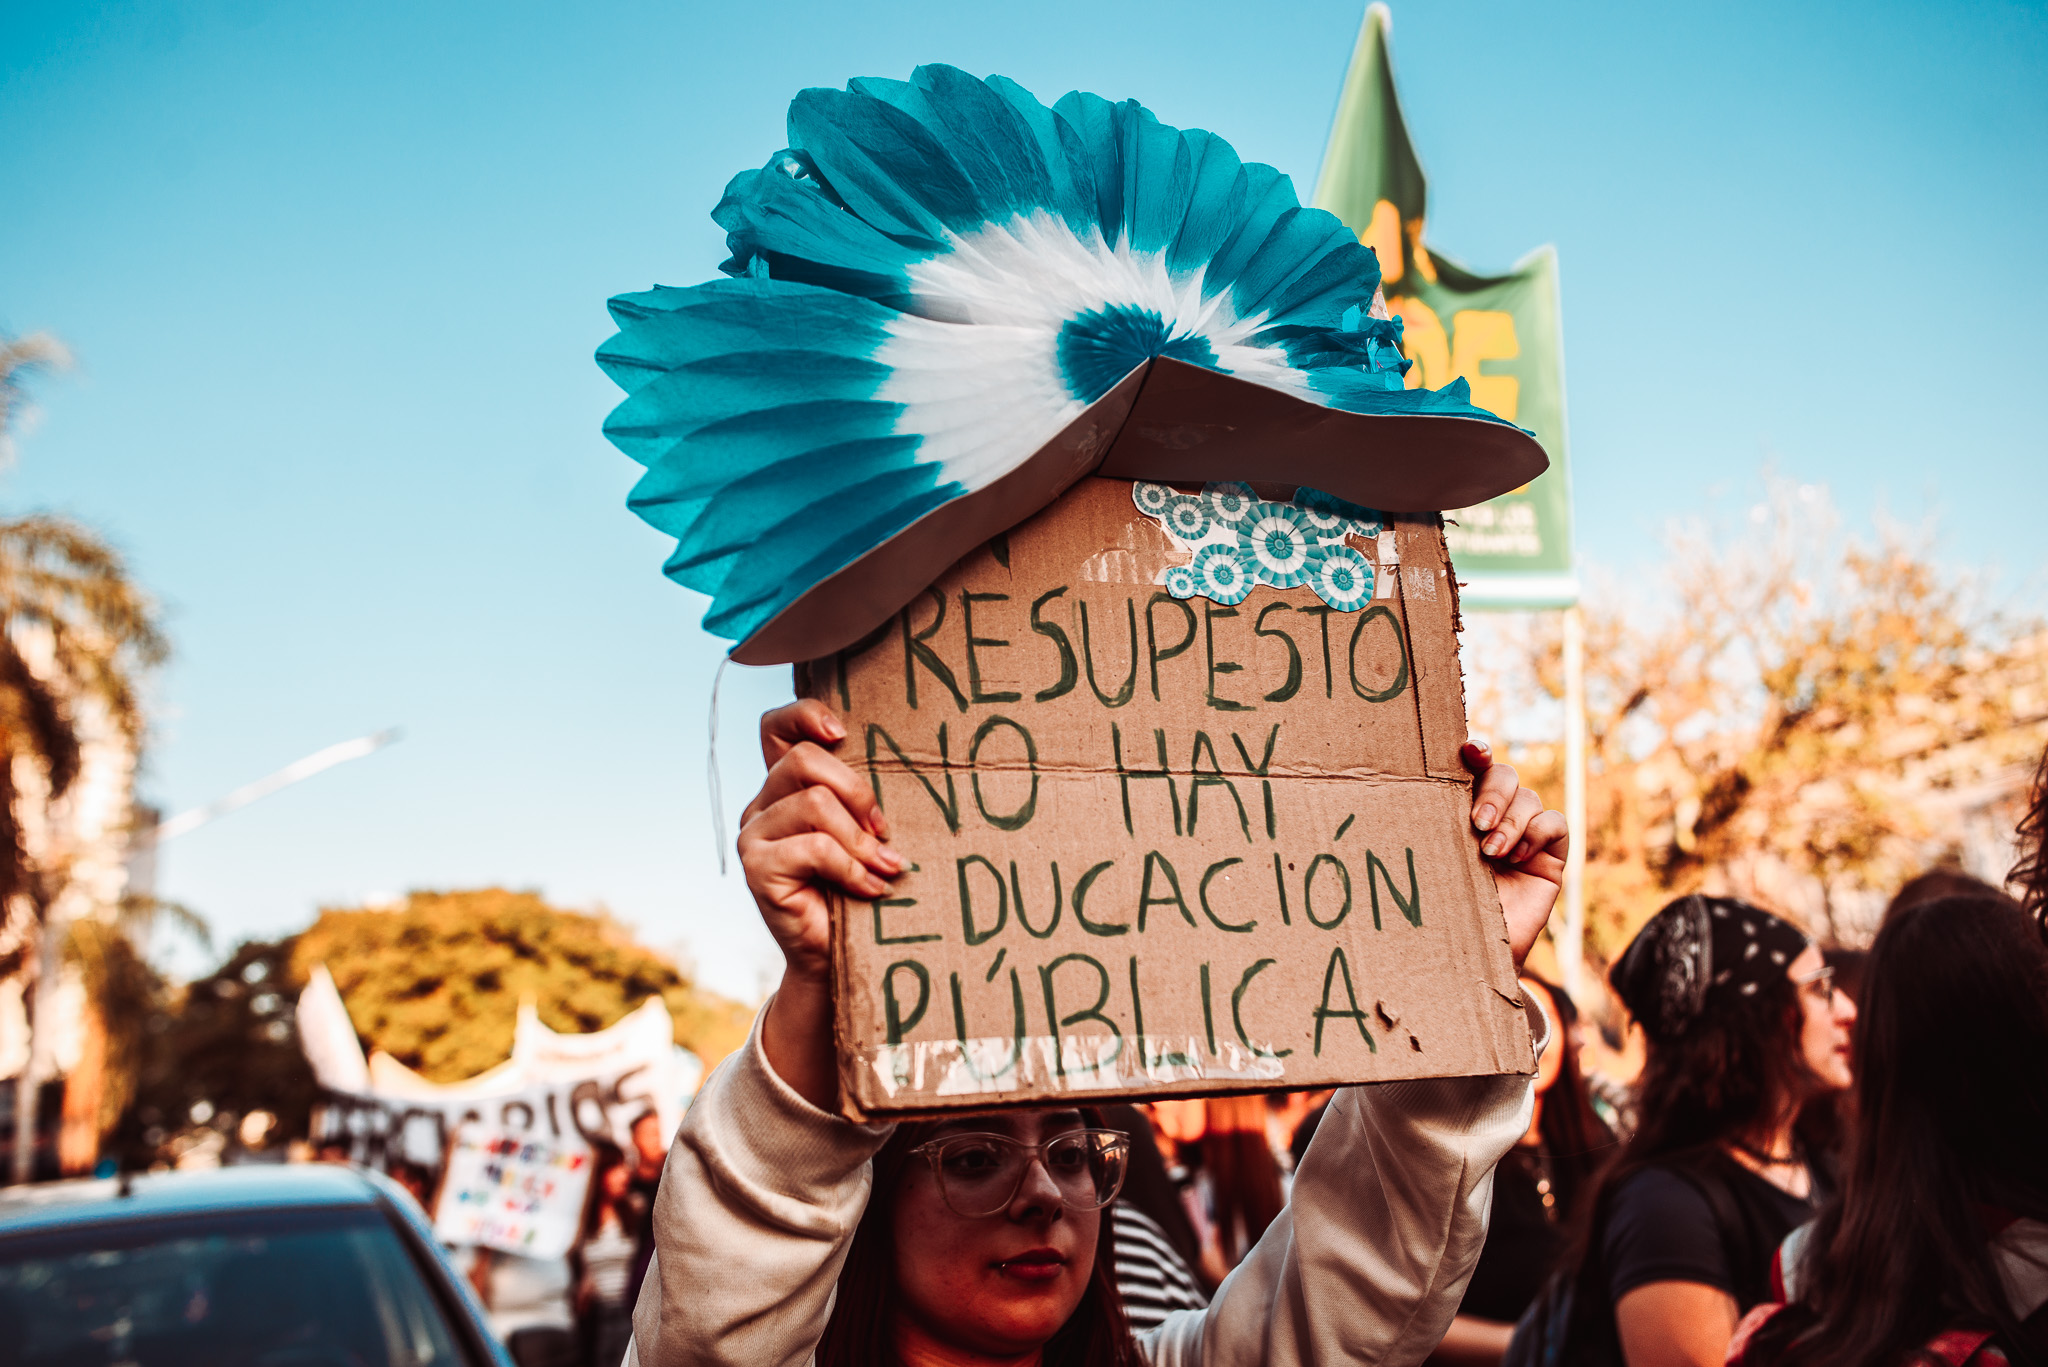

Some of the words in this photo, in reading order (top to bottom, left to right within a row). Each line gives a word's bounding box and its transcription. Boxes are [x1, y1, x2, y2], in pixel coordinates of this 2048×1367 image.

[865, 714, 1038, 834] NO
[1112, 722, 1280, 842] HAY
[871, 813, 1423, 946] EDUCACIÓN
[883, 947, 1377, 1087] PÚBLICA
